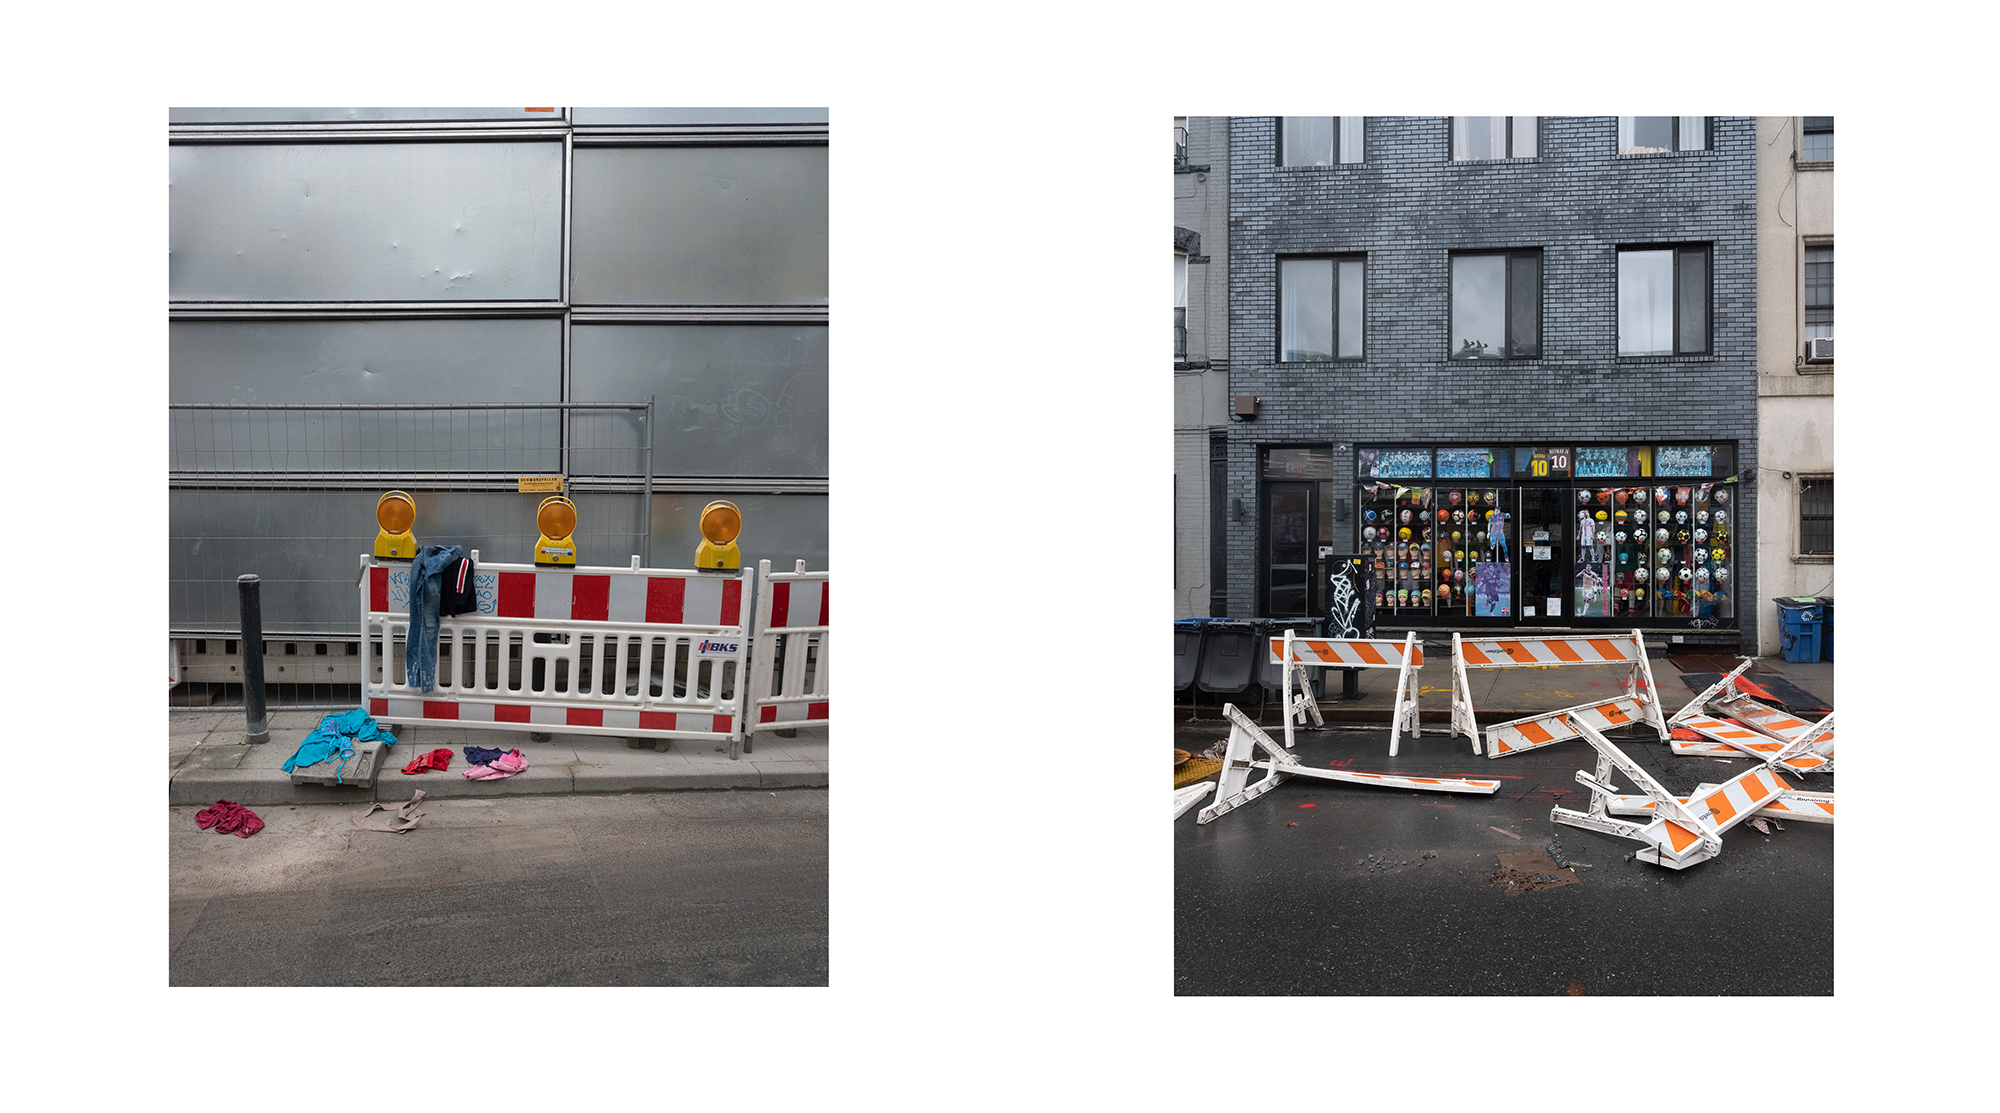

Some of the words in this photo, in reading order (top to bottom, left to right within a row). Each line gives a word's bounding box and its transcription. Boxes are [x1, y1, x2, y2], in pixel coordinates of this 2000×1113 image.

[1520, 455, 1529, 471] 7
[1531, 460, 1548, 477] 10
[1551, 455, 1567, 469] 10
[1601, 564, 1609, 594] Rodriguez
[1601, 595, 1609, 616] James
[710, 642, 739, 653] BKS
